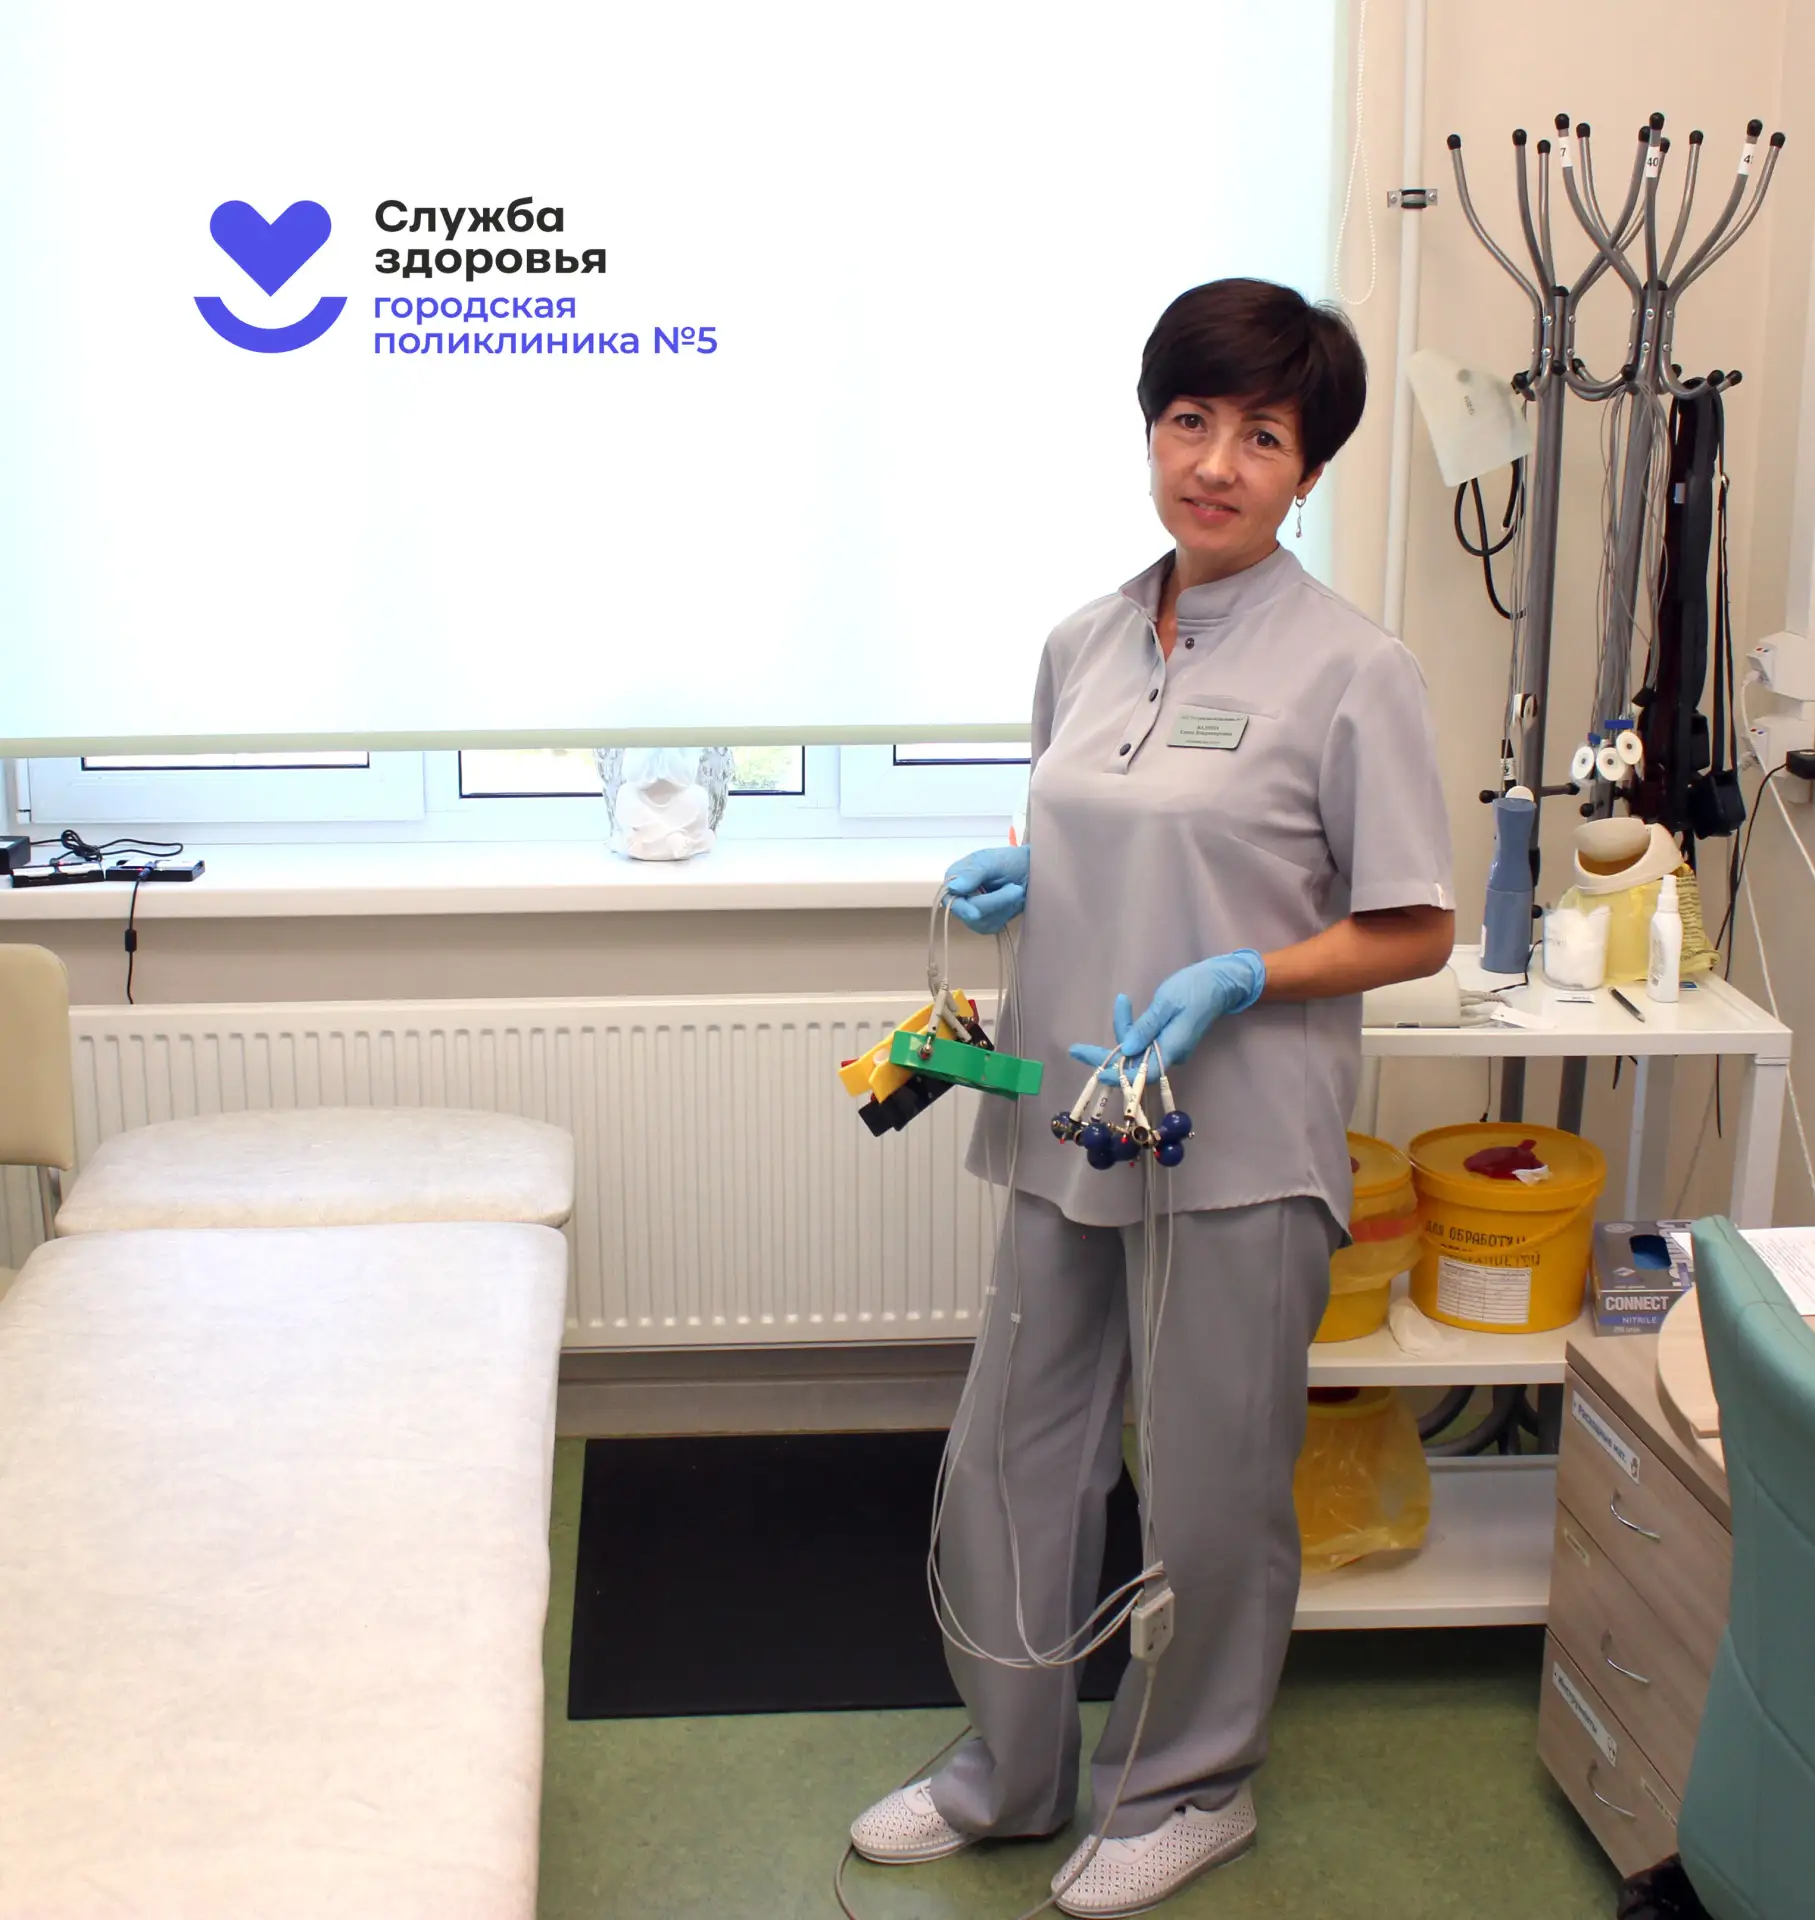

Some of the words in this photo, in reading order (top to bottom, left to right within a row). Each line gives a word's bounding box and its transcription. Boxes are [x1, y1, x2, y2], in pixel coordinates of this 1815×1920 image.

[1647, 157, 1659, 167] 40
[1605, 1296, 1669, 1311] CONNECT
[1622, 1316, 1657, 1324] NITRILE
